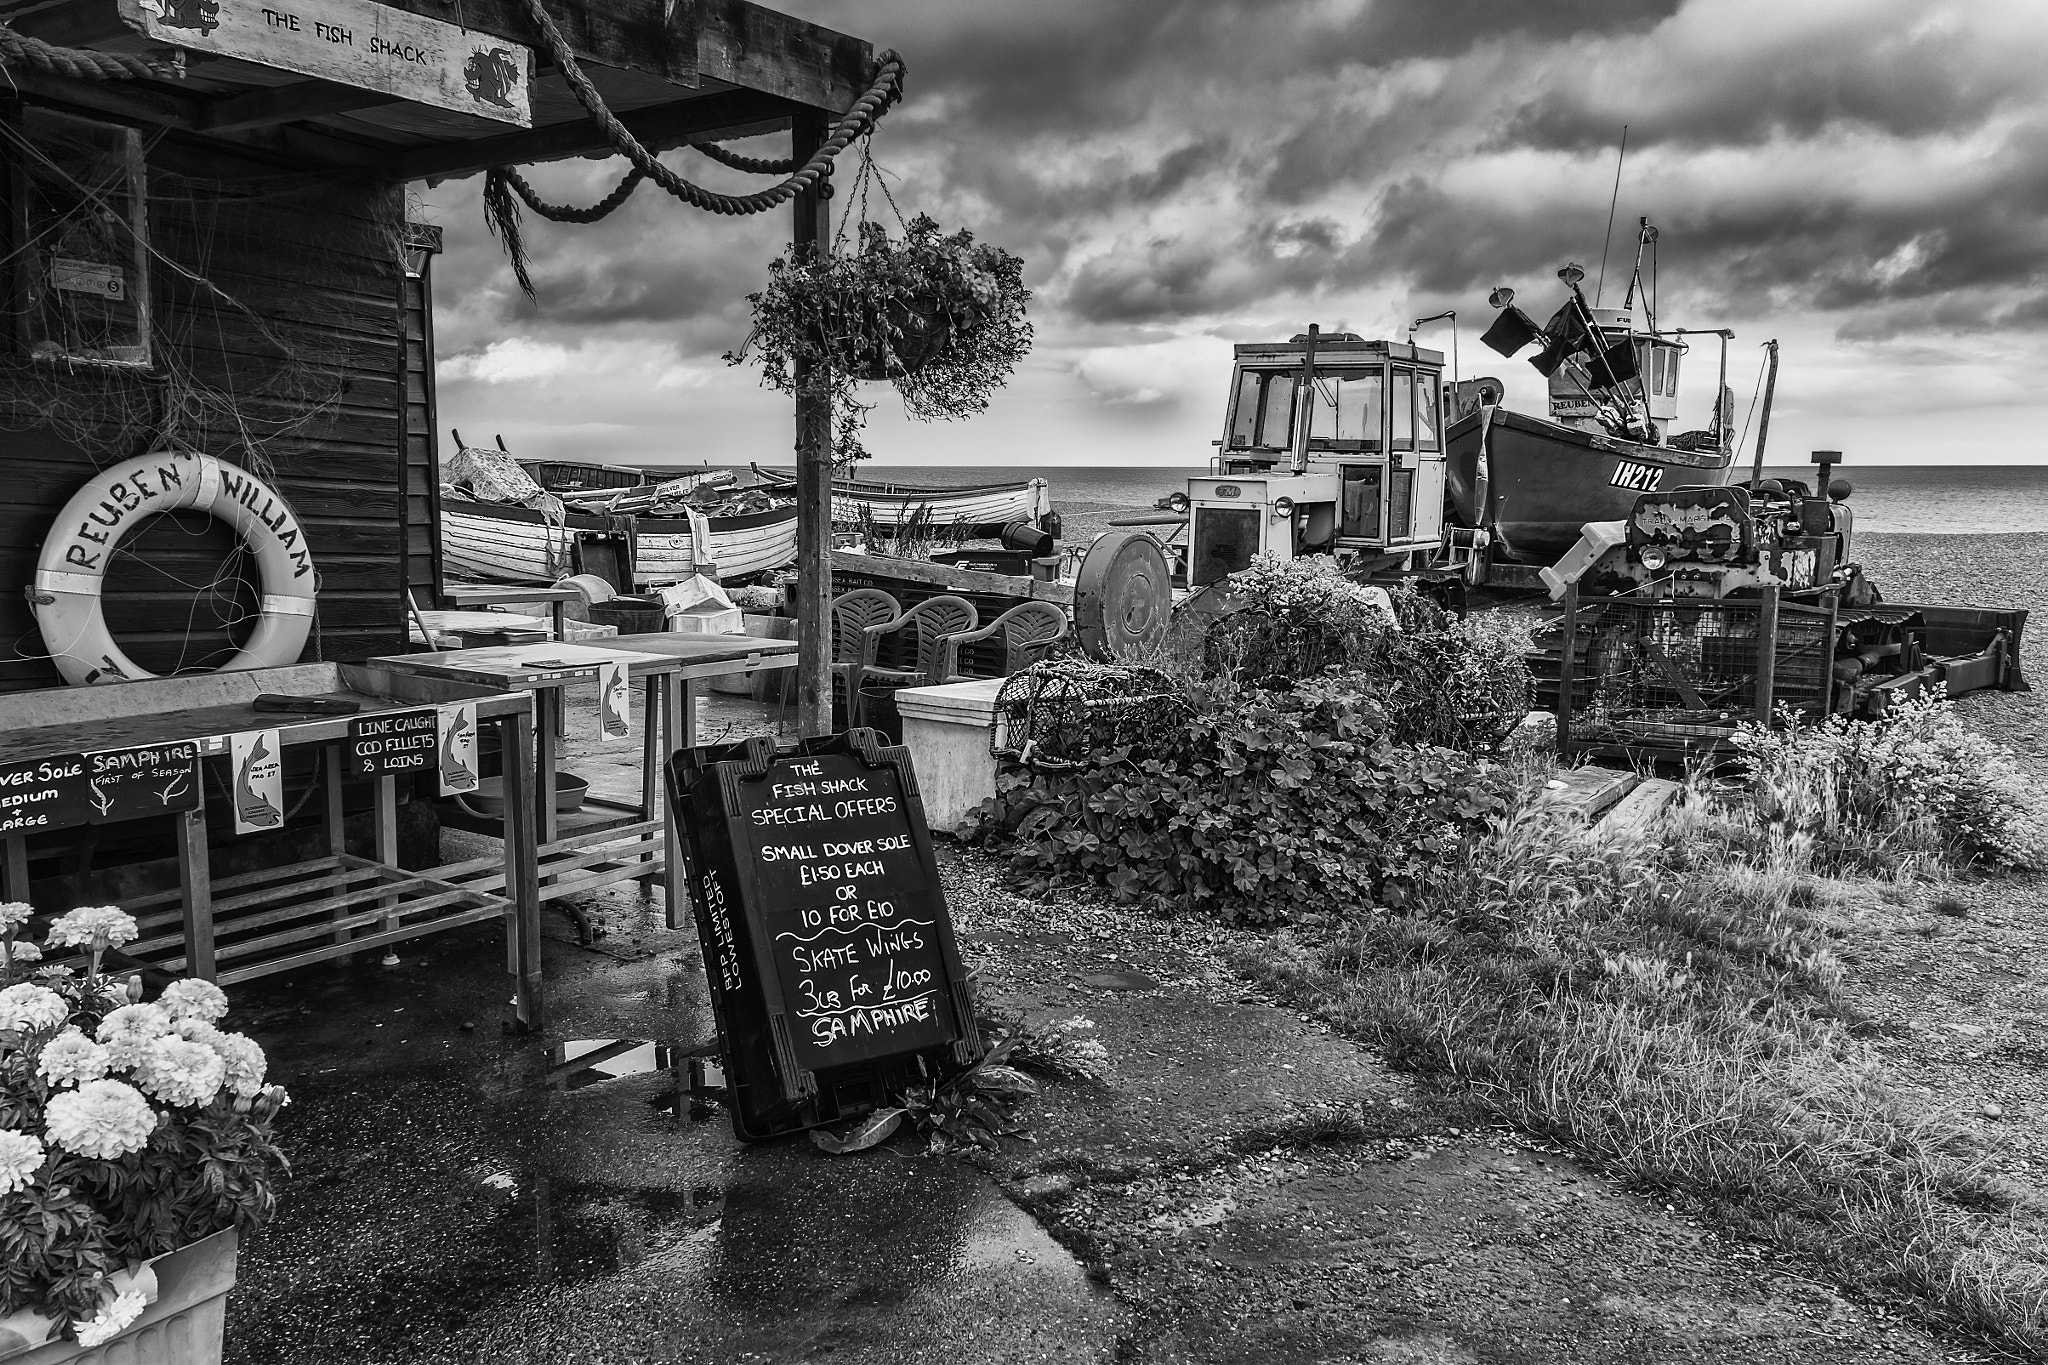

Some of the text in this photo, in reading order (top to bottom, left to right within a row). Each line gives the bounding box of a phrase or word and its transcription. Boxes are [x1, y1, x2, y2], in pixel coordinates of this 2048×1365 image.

[262, 9, 427, 65] THE FISH SHACK
[1610, 461, 1663, 492] IH212
[66, 463, 311, 579] REUBEN WILLIAM
[359, 715, 438, 737] LINE CAUGHT
[356, 733, 435, 757] COD FILLETS
[92, 744, 194, 773] SAMPHIRE
[363, 754, 424, 773] & LOINS
[789, 761, 823, 777] THE
[38, 761, 83, 782] SOLE
[94, 761, 193, 786] FIRST OF SEASON
[0, 789, 59, 808] EDIUM
[771, 776, 869, 799] FISH SHACK
[751, 796, 898, 826] SPECIAL OFFERS
[760, 834, 911, 862] SMALL DOVER SOLE
[845, 860, 886, 878] EACH
[835, 884, 858, 900] OR
[708, 868, 742, 990] LOWESTOFT
[801, 909, 822, 928] 10
[829, 905, 863, 925] FOR
[702, 875, 733, 991] BFP LIMITED
[792, 928, 924, 973] SKATE WINGS
[811, 998, 930, 1047] SAMPHIRE
